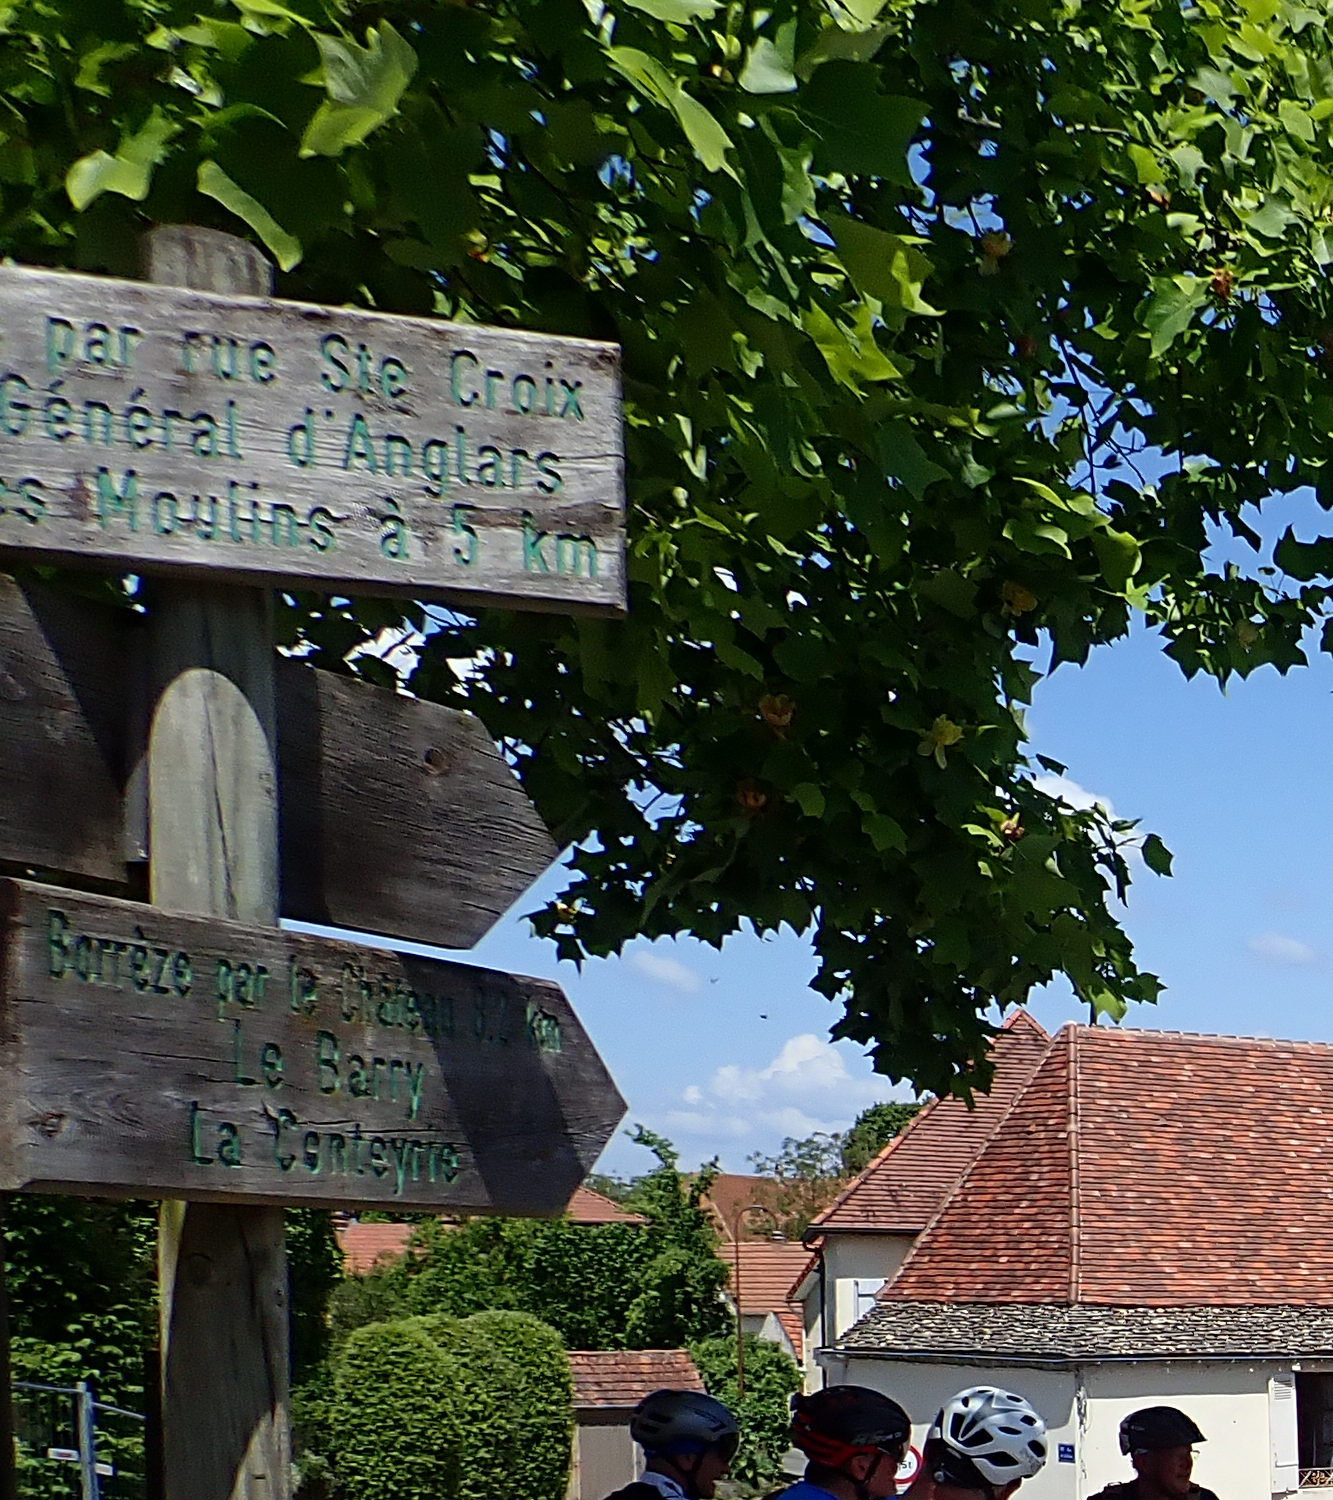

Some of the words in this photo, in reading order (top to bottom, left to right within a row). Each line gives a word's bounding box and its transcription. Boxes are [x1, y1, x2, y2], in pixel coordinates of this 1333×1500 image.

[47, 316, 141, 375] par
[182, 330, 276, 384] rue
[320, 333, 408, 399] Ste
[450, 348, 584, 422] Croix
[0, 373, 243, 460] Général
[288, 406, 564, 499] d'Anglars
[96, 465, 335, 552] Moulins
[380, 496, 410, 561] à
[452, 502, 479, 567] 5
[522, 509, 598, 578] km
[216, 957, 269, 1023] par
[289, 953, 318, 1016] le
[524, 995, 562, 1054] km
[231, 1018, 286, 1090] Le
[316, 1028, 426, 1121] Barry
[188, 1100, 242, 1169] La
